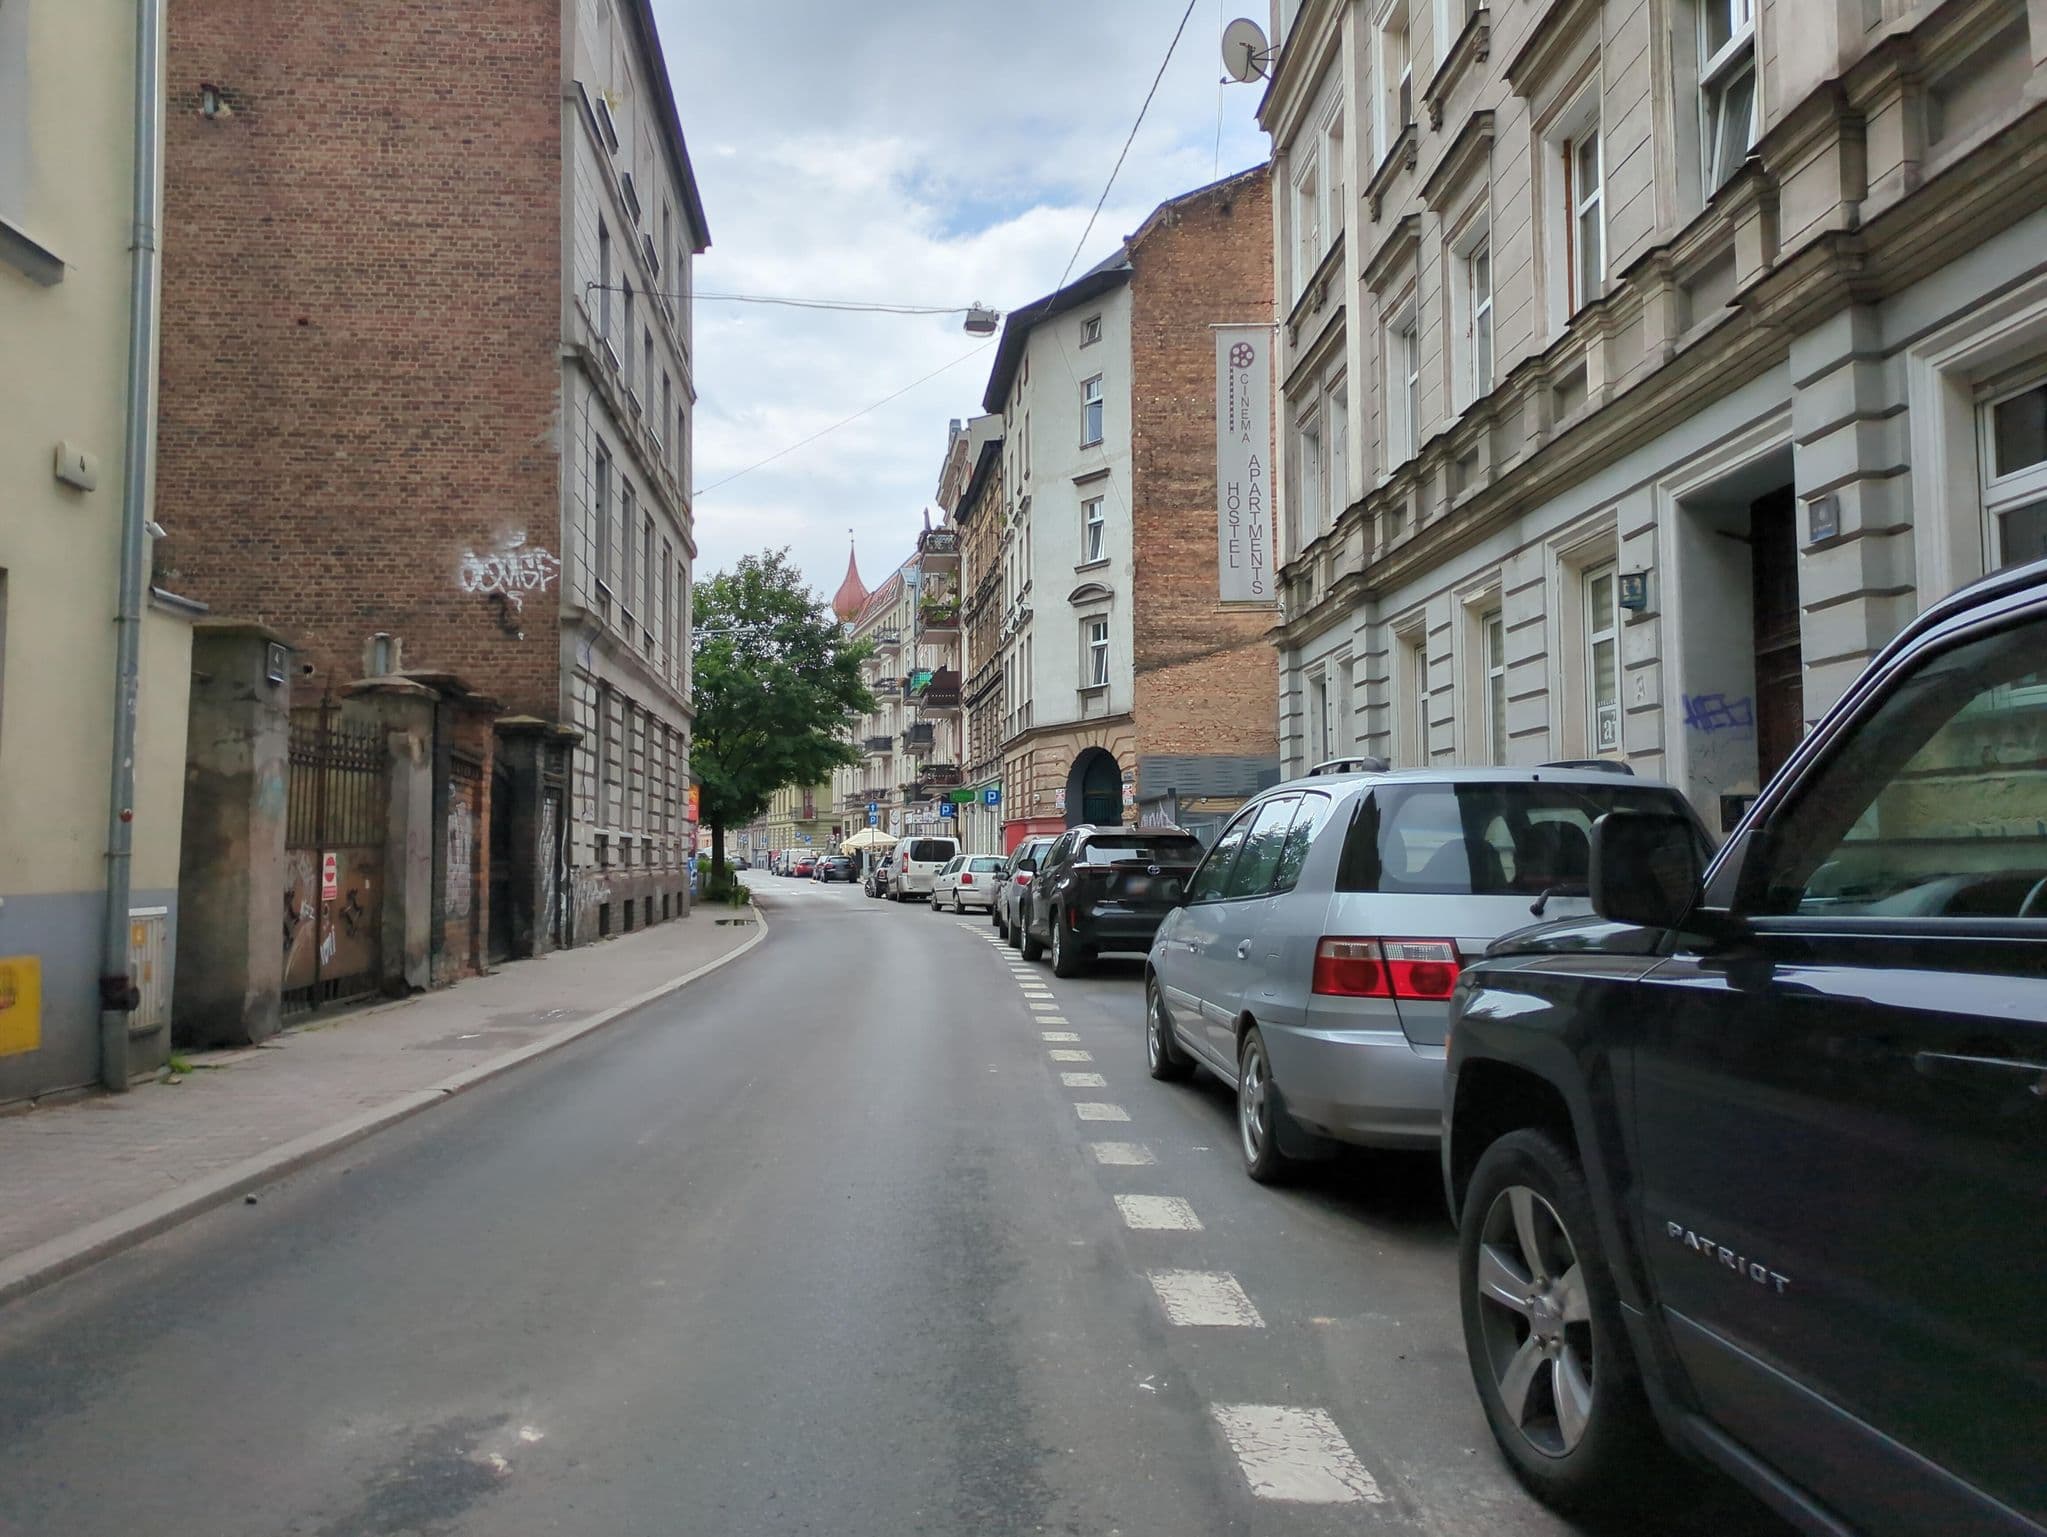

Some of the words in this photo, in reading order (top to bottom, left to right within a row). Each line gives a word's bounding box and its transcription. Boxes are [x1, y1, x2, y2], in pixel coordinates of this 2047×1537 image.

[1240, 373, 1251, 443] CINEMA
[1227, 482, 1240, 569] HOSTEL
[1248, 454, 1263, 595] APARTMENTS
[1667, 1221, 1790, 1294] PATRIOT
